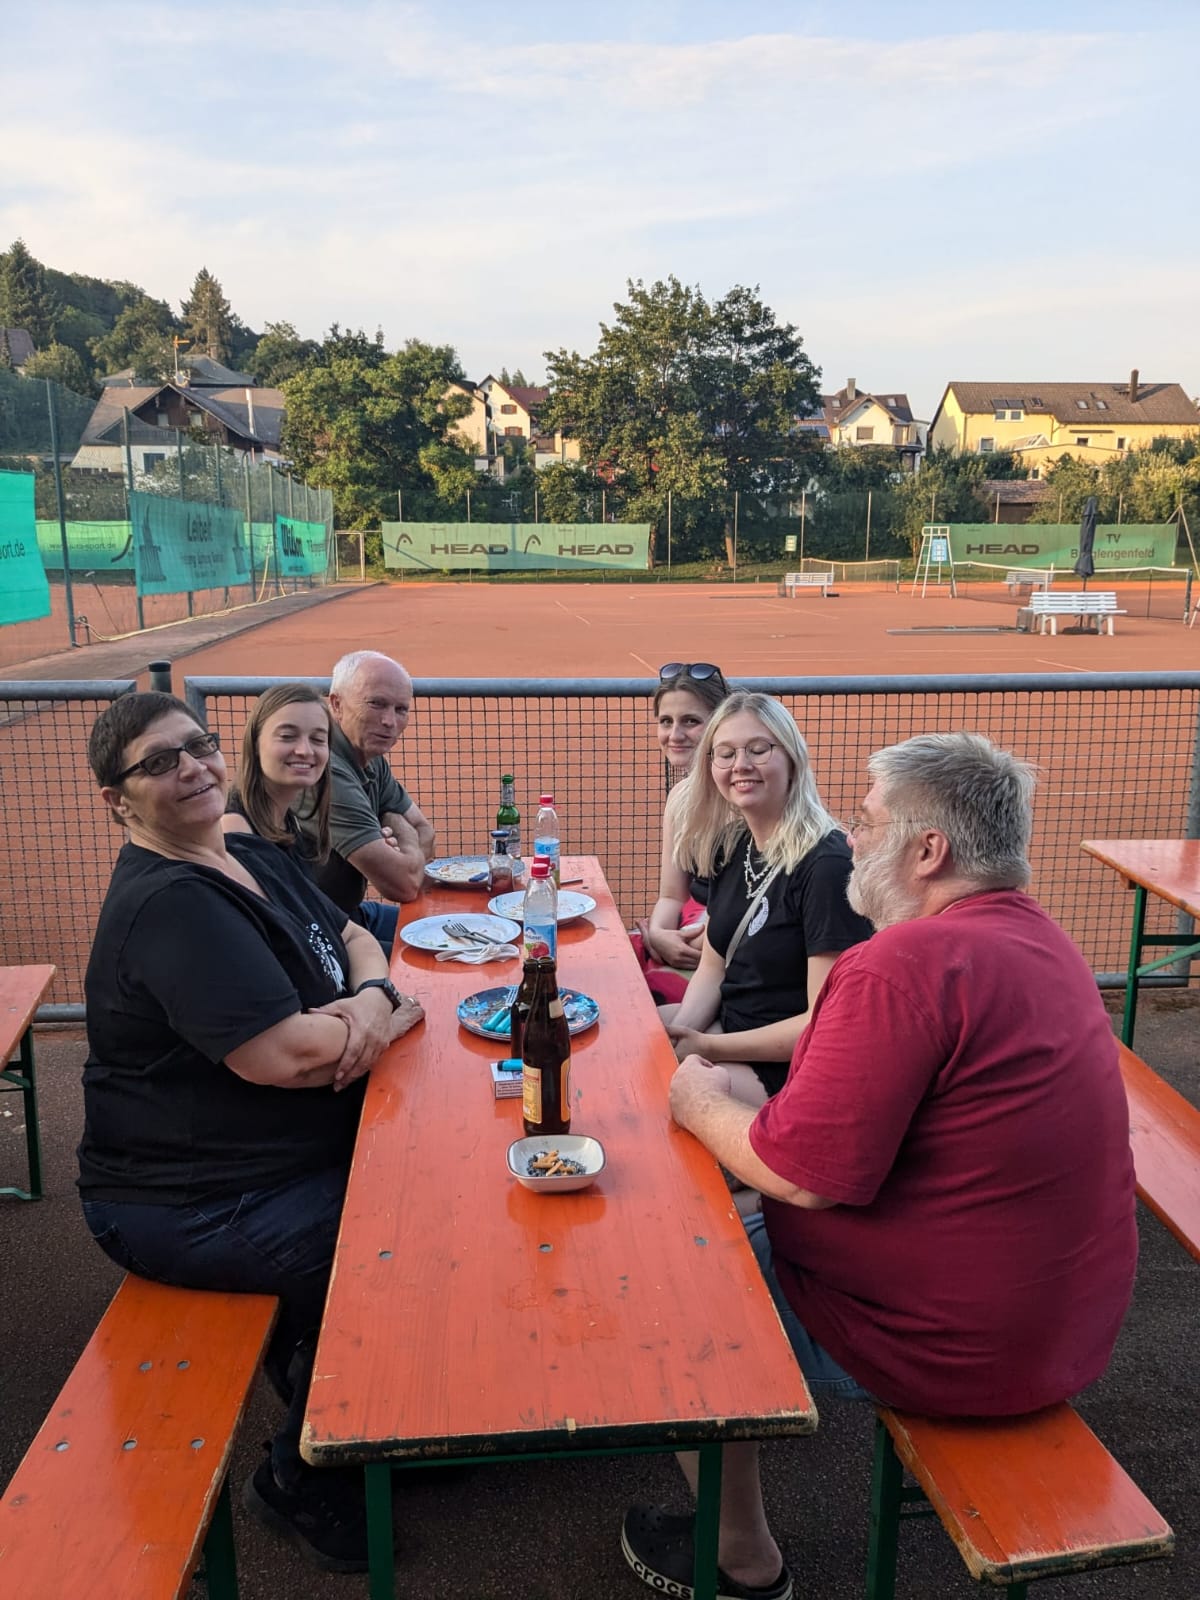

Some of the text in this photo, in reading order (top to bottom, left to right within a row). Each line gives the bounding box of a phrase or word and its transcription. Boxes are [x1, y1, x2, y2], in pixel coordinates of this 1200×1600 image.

[1106, 533, 1121, 544] TV
[430, 543, 509, 555] HEAD
[558, 544, 634, 556] HEAD
[966, 543, 1040, 555] HEAD
[1070, 547, 1155, 561] Bglengenfeld
[633, 1561, 692, 1600] crocs
